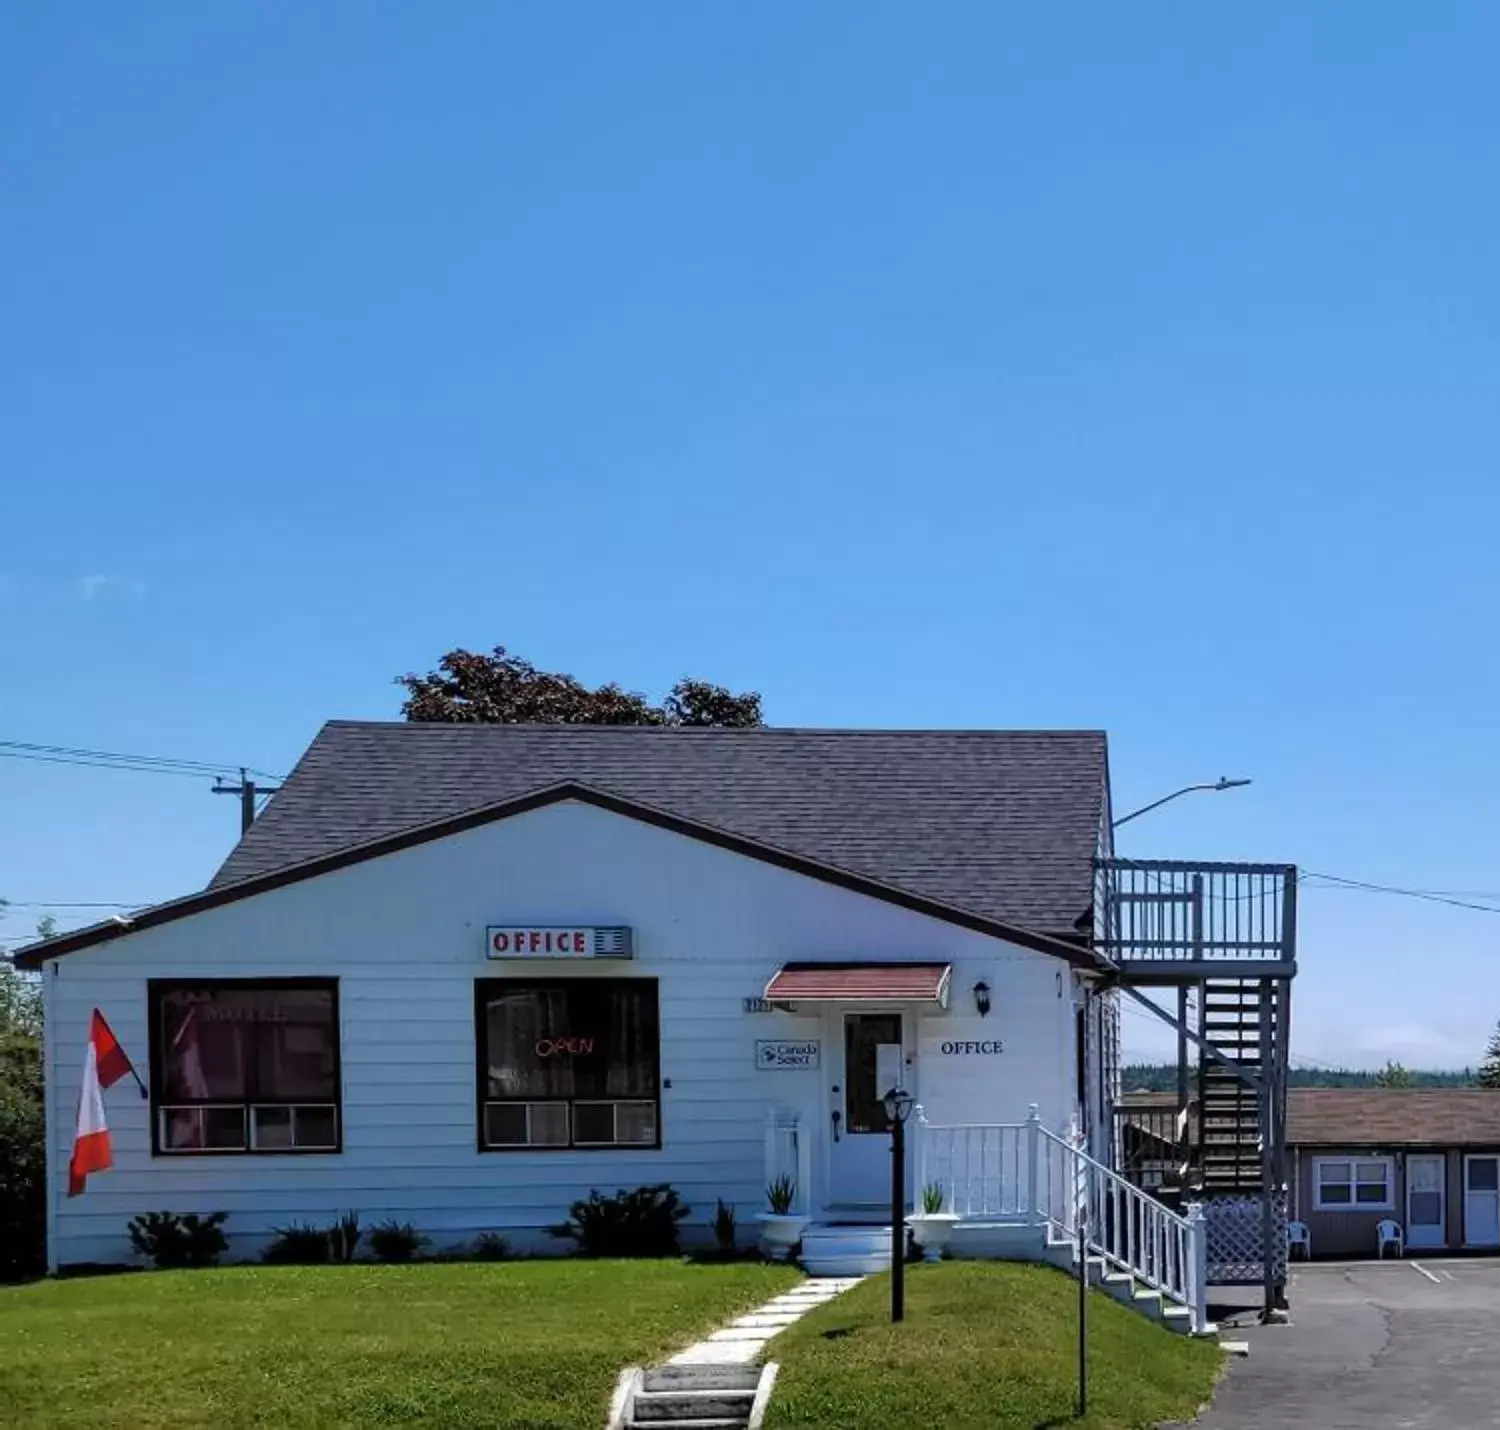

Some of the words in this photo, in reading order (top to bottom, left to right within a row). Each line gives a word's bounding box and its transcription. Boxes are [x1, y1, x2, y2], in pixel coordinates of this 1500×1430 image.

[493, 932, 586, 952] OFFICE
[536, 1038, 593, 1056] OPEN
[777, 1043, 817, 1055] Canada
[941, 1041, 1004, 1055] OFFICE
